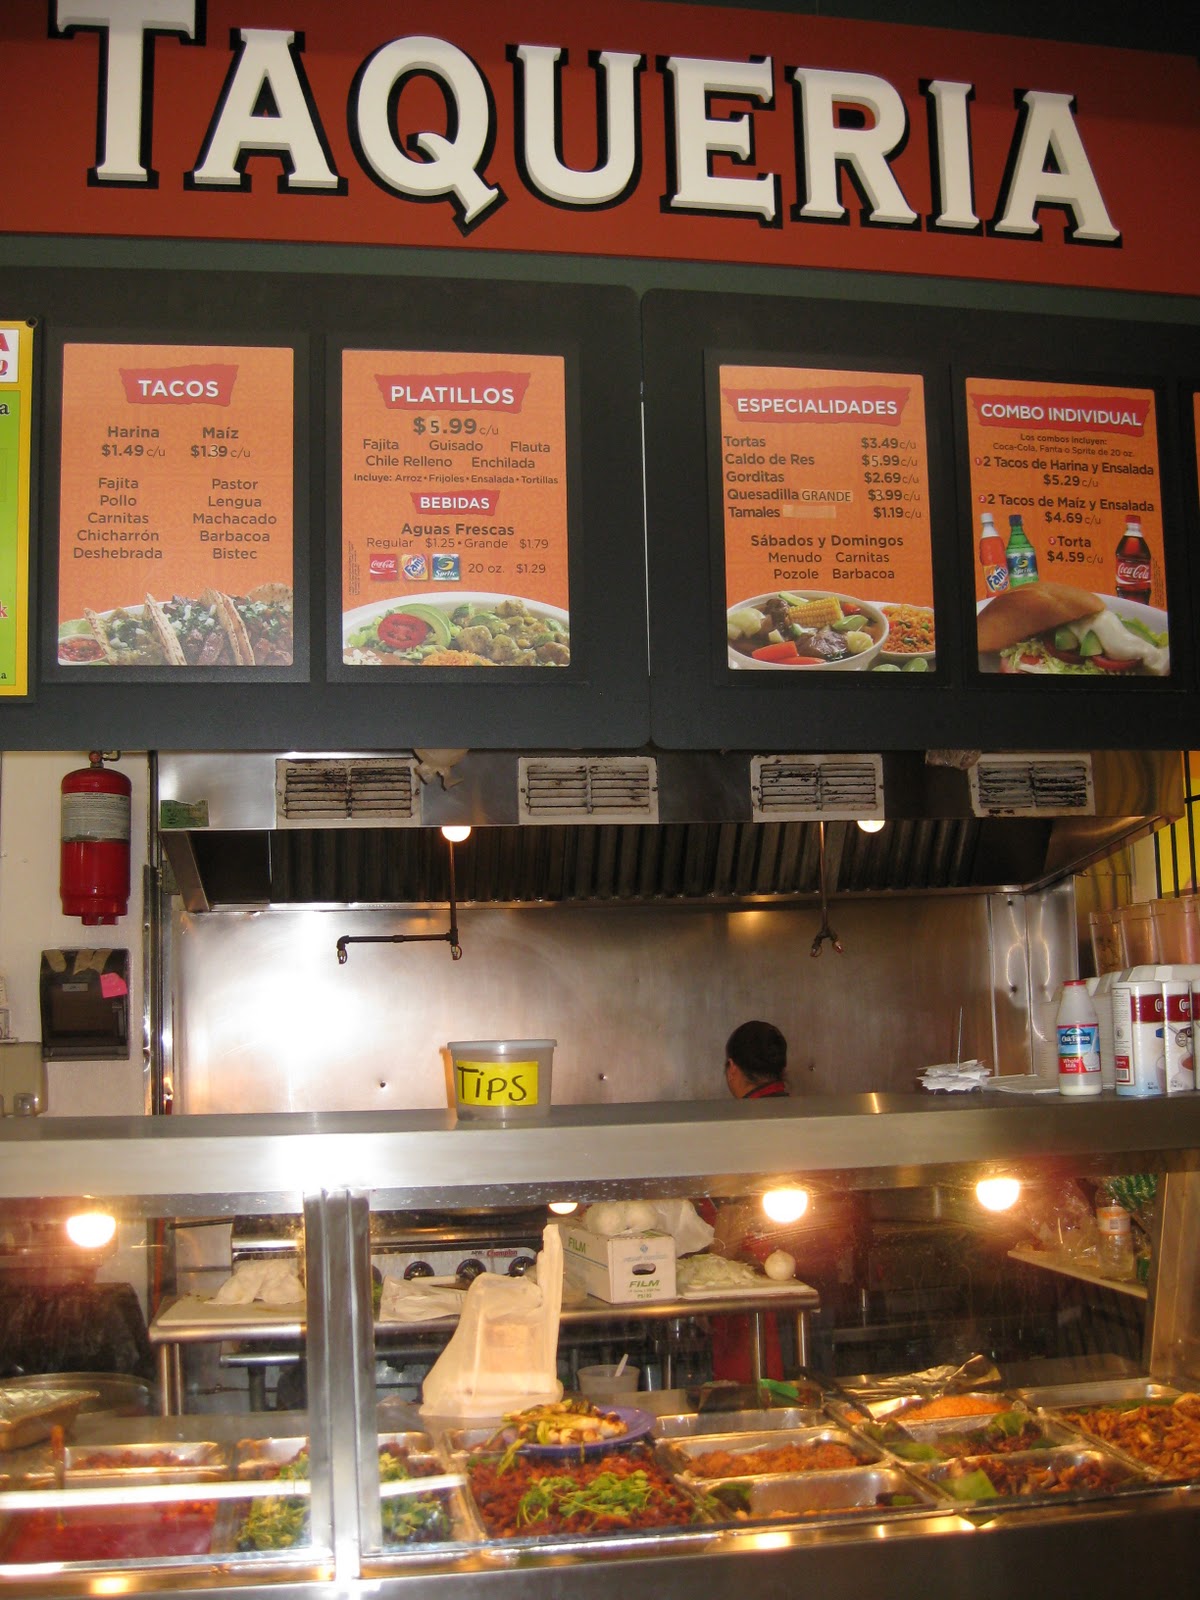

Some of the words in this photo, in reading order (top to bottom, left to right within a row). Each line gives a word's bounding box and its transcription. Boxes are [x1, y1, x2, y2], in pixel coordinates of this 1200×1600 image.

[51, 0, 1120, 246] TAQUERIA
[138, 379, 219, 398] TACOS
[391, 385, 514, 405] PLATILLOS
[737, 398, 897, 415] ESPECIALIDADES
[980, 403, 1044, 420] COMBO
[1049, 407, 1142, 427] INDIVIDUAL
[413, 416, 477, 435] $5.99
[479, 425, 499, 435] c/u
[107, 426, 160, 439] Harina
[202, 426, 239, 439] Maíz
[363, 439, 399, 451] Fajita
[724, 435, 766, 447] Tortas
[861, 437, 898, 449] $3.49
[900, 440, 916, 449] c/u
[1021, 433, 1034, 441] Los
[1037, 435, 1069, 443] combos
[1072, 437, 1107, 445] incluyen:
[101, 444, 144, 458] $1.49
[147, 445, 165, 457] c/u
[190, 444, 228, 459] $1.39
[231, 447, 251, 459] c/u
[429, 440, 483, 451] Guisado
[510, 441, 550, 452] Flauta
[1040, 445, 1062, 454] Fanta
[1072, 447, 1095, 456] Sprite
[1098, 448, 1108, 456] de
[1111, 449, 1121, 457] 20
[366, 456, 399, 467] Chile
[403, 456, 452, 468] Relleno
[472, 457, 535, 468] Enchilada
[725, 454, 765, 464] Caldo
[770, 454, 786, 464] de
[790, 454, 814, 465] Res
[862, 454, 899, 467] $5.99
[901, 457, 917, 467] c/u
[983, 457, 991, 467] 2
[994, 457, 1028, 468] Tacos
[1032, 458, 1047, 469] de
[1051, 460, 1088, 472] Harina
[1092, 463, 1098, 474] y
[1102, 462, 1154, 475] Ensalada
[354, 474, 392, 483] Incluye:
[395, 474, 422, 482] Arroz
[429, 474, 464, 483] Frijoles
[471, 475, 514, 483] Ensalada
[521, 476, 558, 484] Tortillas
[726, 471, 784, 482] Gorditas
[864, 472, 901, 484] $2.69
[902, 474, 919, 484] c/u
[1043, 474, 1080, 487] $5.29
[1082, 479, 1098, 488] c/u
[98, 477, 139, 492] Fajita
[212, 478, 258, 491] Pastor
[100, 494, 137, 507] Pollo
[727, 489, 798, 500] Quesadilla
[802, 490, 851, 501] GRANDE
[868, 489, 902, 501] $3.99
[903, 491, 920, 501] c/u
[208, 496, 262, 509] Lengua
[420, 497, 490, 509] BEBIDAS
[988, 494, 995, 504] 2
[999, 494, 1034, 506] Tacos
[1038, 496, 1054, 507] de
[1058, 497, 1085, 508] Maíz
[1089, 500, 1096, 512] y
[1101, 499, 1154, 512] Ensalada
[87, 512, 149, 524] Carnitas
[728, 506, 780, 518] Tamales
[873, 506, 903, 519] $1.19
[904, 509, 921, 519] c/u
[193, 512, 277, 525] Machacado
[1045, 512, 1082, 523] $4.69
[1084, 515, 1101, 525] c/u
[77, 529, 159, 542] Chicharrón
[200, 530, 270, 542] Barbacoa
[401, 523, 450, 538] Aguas
[455, 524, 514, 536] Frescas
[367, 538, 413, 550] Regular
[425, 538, 455, 548] $1.25
[464, 539, 508, 549] Grande
[520, 539, 548, 549] $1.79
[751, 534, 813, 546] Sábados
[818, 537, 826, 548] y
[831, 535, 903, 548] Domingos
[1058, 536, 1091, 548] Torta
[73, 547, 163, 560] Deshebrada
[213, 548, 257, 560] Bistec
[768, 552, 822, 563] Menudo
[836, 552, 890, 563] Carnitas
[1047, 551, 1085, 563] $4.59
[1086, 555, 1103, 563] c/u
[468, 564, 484, 573] 20
[488, 565, 505, 573] oz.
[516, 564, 546, 574] $1.29
[774, 568, 819, 579] Pozole
[833, 569, 895, 579] Barbacoa
[568, 1236, 586, 1254] FILM
[629, 1280, 660, 1288] FILM
